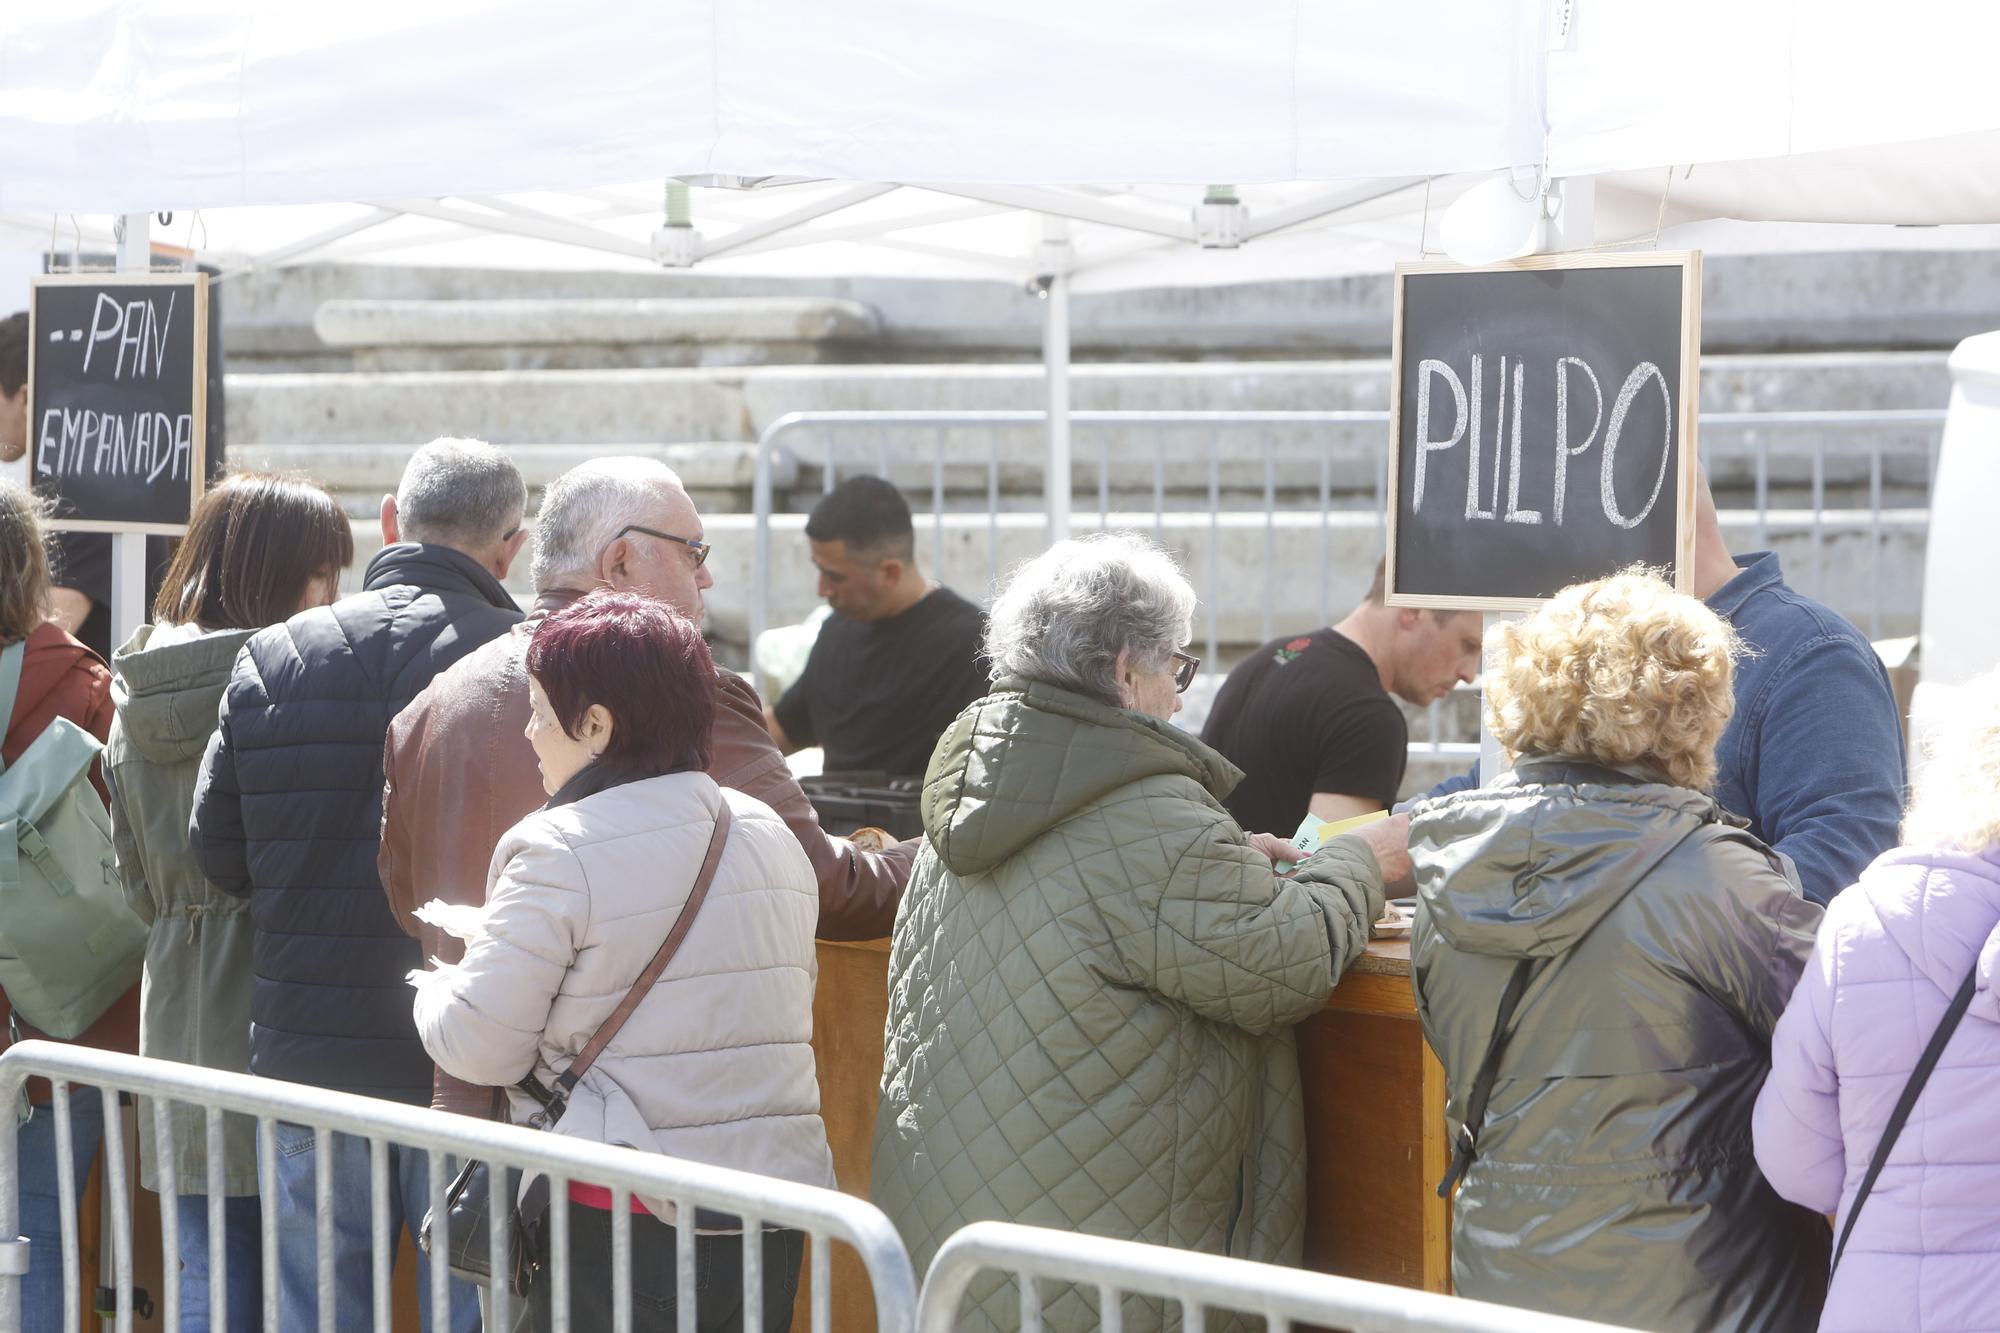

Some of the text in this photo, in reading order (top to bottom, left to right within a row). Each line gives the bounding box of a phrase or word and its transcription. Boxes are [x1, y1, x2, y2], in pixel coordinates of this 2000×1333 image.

[37, 408, 192, 484] EMPANADA
[1413, 355, 1671, 528] PULPO
[1297, 837, 1310, 850] AN
